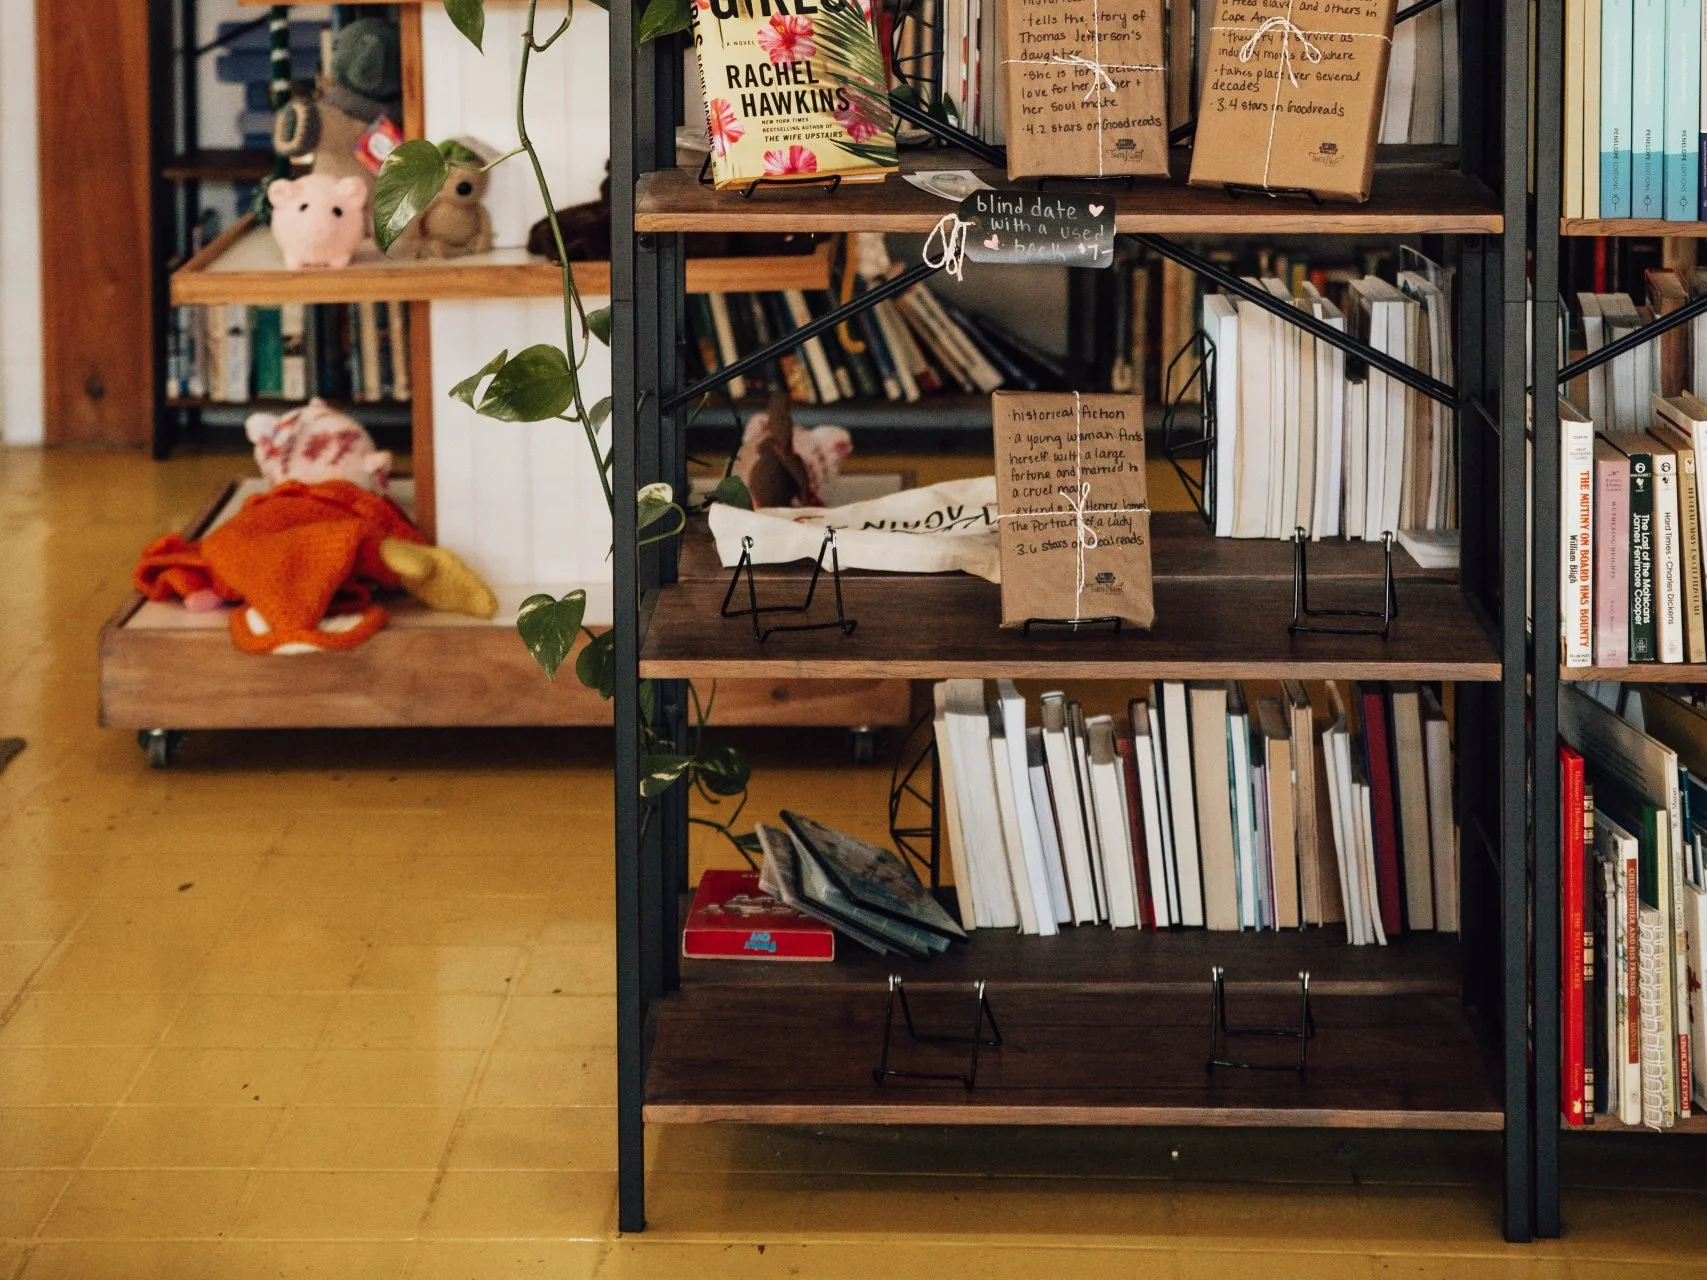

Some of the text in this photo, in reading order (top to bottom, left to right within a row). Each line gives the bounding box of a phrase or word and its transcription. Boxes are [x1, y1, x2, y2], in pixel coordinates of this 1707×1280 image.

[1222, 11, 1245, 22] Cape
[1300, 1, 1318, 12] and
[1324, 4, 1360, 15] others
[1028, 10, 1146, 26] tells of
[1020, 32, 1066, 43] Thomas
[1340, 34, 1354, 43] as
[726, 60, 820, 89] RACHEL
[1057, 70, 1066, 78] is
[1219, 65, 1360, 82] takes several
[1022, 81, 1089, 99] love for her
[1212, 80, 1260, 92] decades
[741, 87, 850, 117] HAWKINS
[1022, 97, 1118, 114] her mate
[1216, 97, 1345, 116] 3.4 stars Goodreads
[1026, 115, 1162, 134] 4.2 stars Goodreads
[805, 132, 843, 140] UPSTAIRS
[977, 194, 1078, 220] blind date
[991, 217, 1104, 241] with a used
[1013, 404, 1125, 422] historical fiction
[1014, 433, 1062, 450] a young
[1009, 451, 1049, 464] herself
[1095, 449, 1125, 464] large
[1011, 463, 1123, 481] fortune and married
[1580, 470, 1590, 490] THE
[1012, 485, 1052, 498] a cruel
[1580, 494, 1590, 530] MUTINY
[1008, 517, 1132, 532] The Portrait Lady
[1017, 539, 1068, 556] 3.6 stars
[1580, 532, 1590, 546] ON
[1568, 534, 1578, 584] William Bligh
[1580, 550, 1590, 582] BOARD
[1633, 513, 1642, 626] James Fenimore Cooper
[1642, 514, 1652, 624] The Last of the Mohicans
[1666, 561, 1674, 592] Charles
[1580, 585, 1590, 606] HMS
[1580, 608, 1590, 647] BOUNTY
